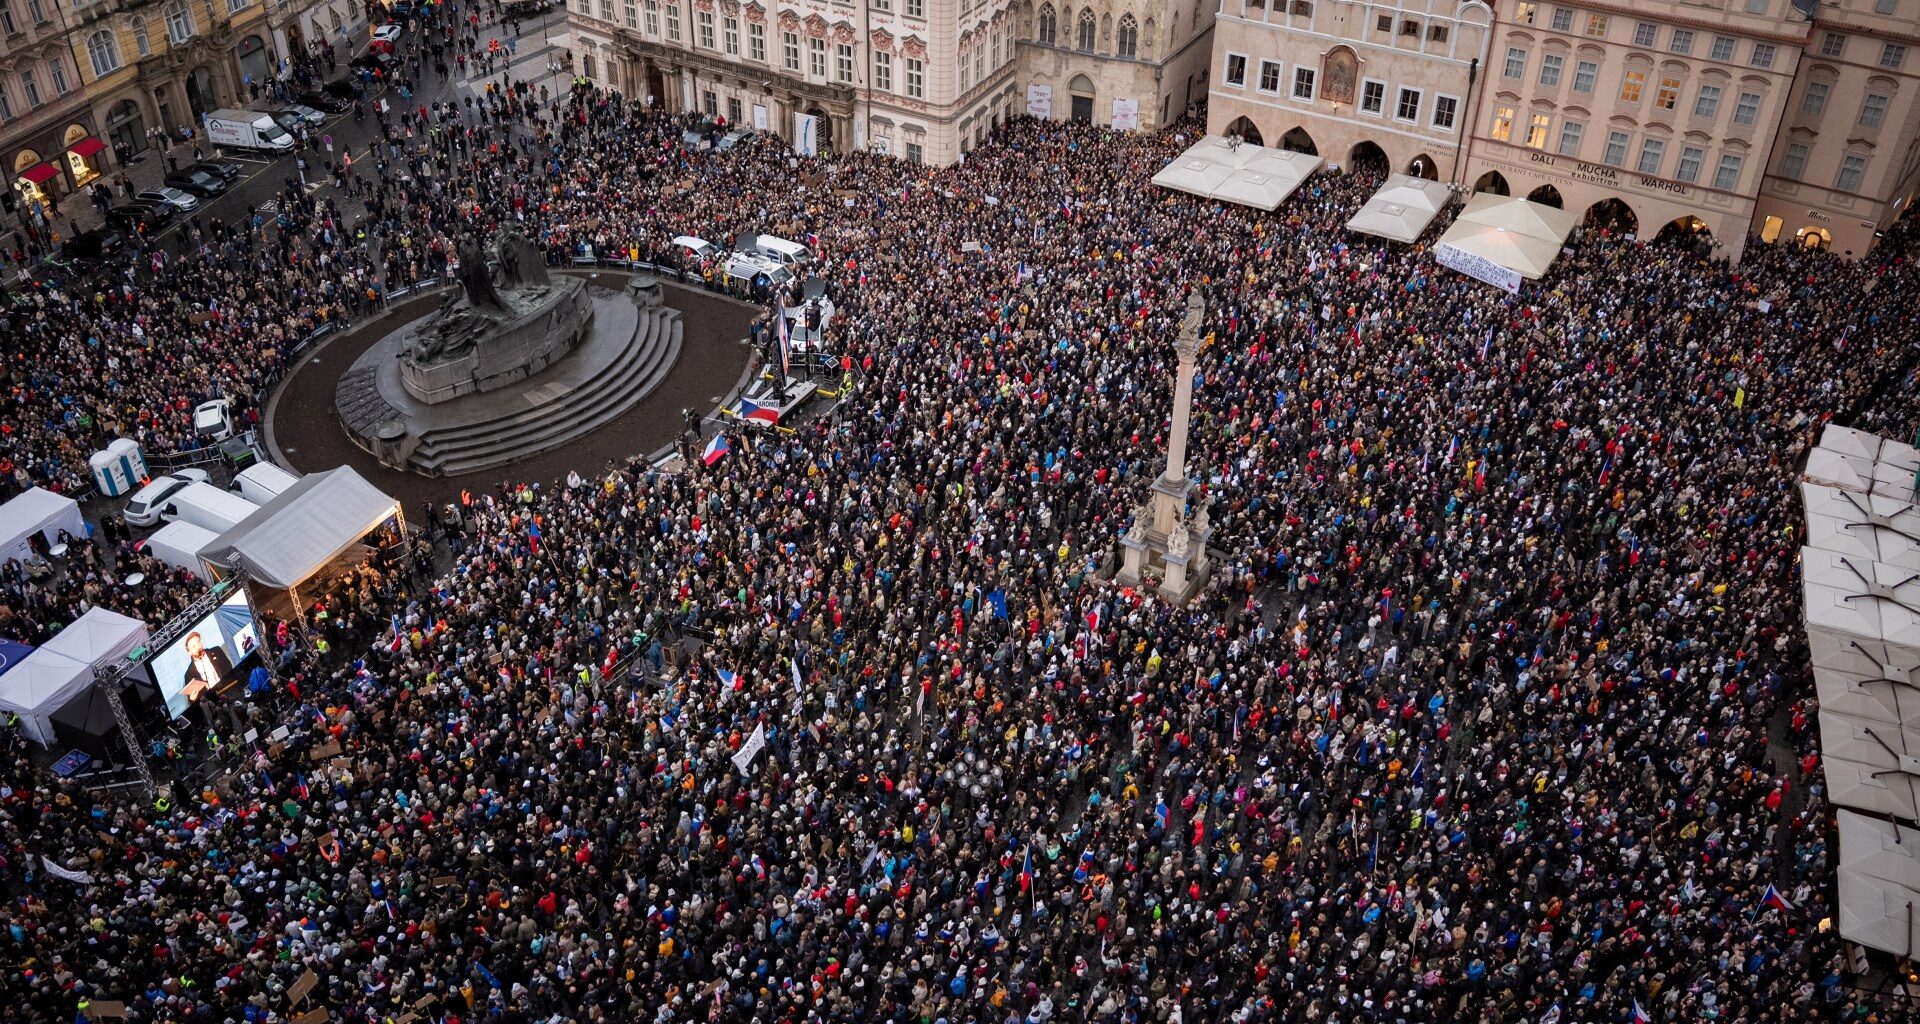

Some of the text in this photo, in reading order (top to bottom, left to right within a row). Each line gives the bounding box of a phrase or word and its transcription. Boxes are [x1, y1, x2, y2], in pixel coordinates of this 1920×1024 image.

[1481, 161, 1527, 176] RESTAURANT
[1577, 163, 1616, 179] MUCHA
[1571, 172, 1619, 187] exhibition
[1641, 177, 1686, 194] WARHOL
